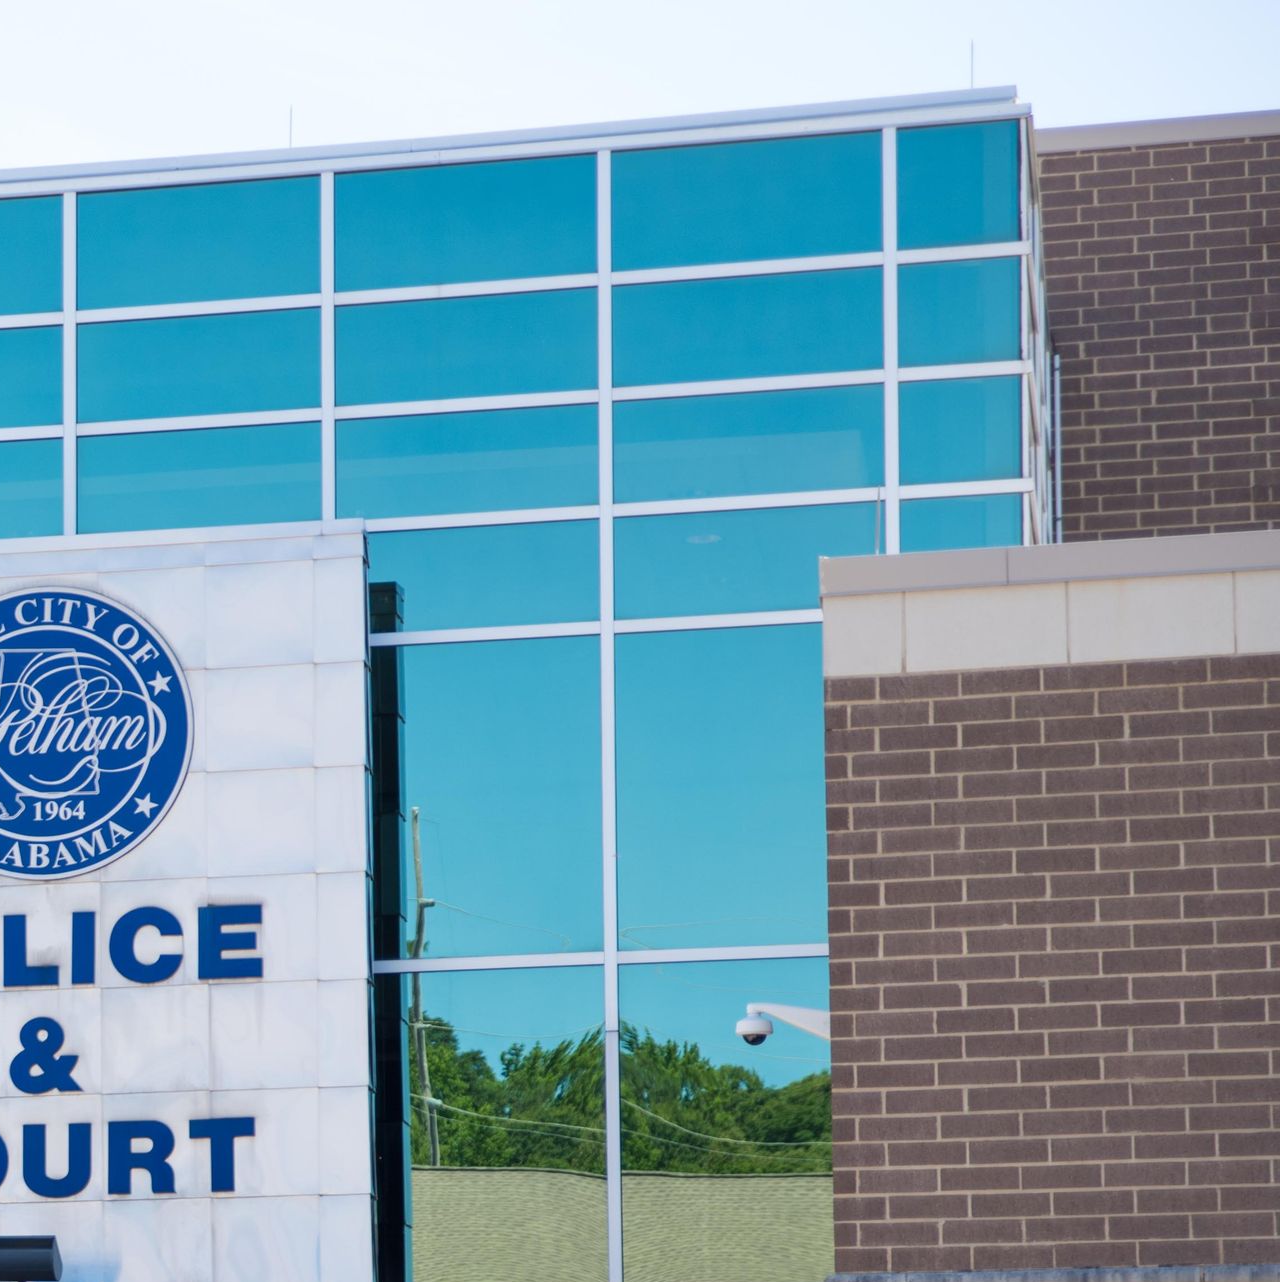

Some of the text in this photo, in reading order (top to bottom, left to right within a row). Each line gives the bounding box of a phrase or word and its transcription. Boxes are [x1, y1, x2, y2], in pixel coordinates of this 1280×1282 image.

[14, 598, 109, 632] CITY
[111, 623, 160, 665] OF
[32, 801, 86, 821] 1964
[9, 1017, 82, 1094] &
